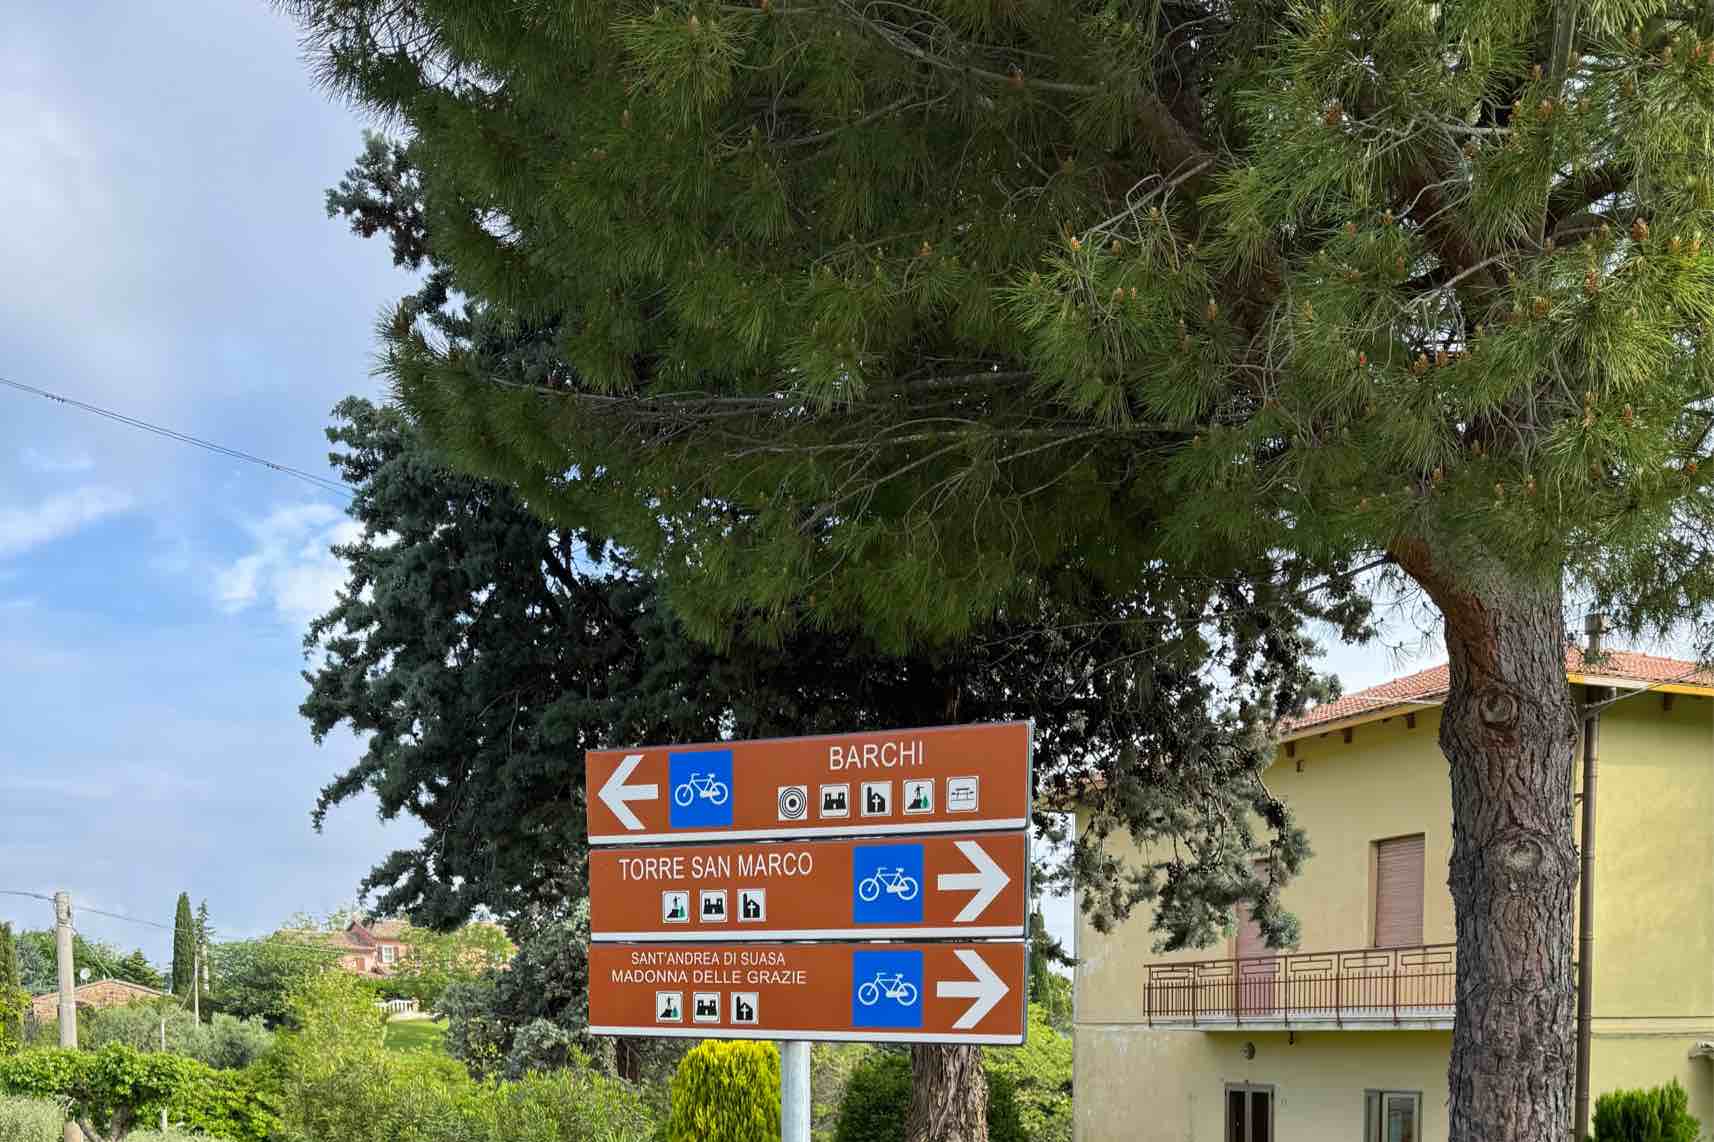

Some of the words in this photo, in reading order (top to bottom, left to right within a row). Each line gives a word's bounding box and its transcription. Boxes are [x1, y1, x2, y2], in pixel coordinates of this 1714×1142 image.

[829, 739, 923, 771] BARCHI
[618, 856, 685, 881] TORRE
[691, 855, 731, 880] SAN
[737, 851, 813, 877] MARCO
[631, 951, 720, 966] SANT'ANDREA
[723, 951, 737, 966] DI
[740, 951, 786, 966] SUASA
[611, 969, 689, 984] MADONNA
[692, 969, 742, 984] DELLE
[746, 970, 808, 985] GRAZIE
